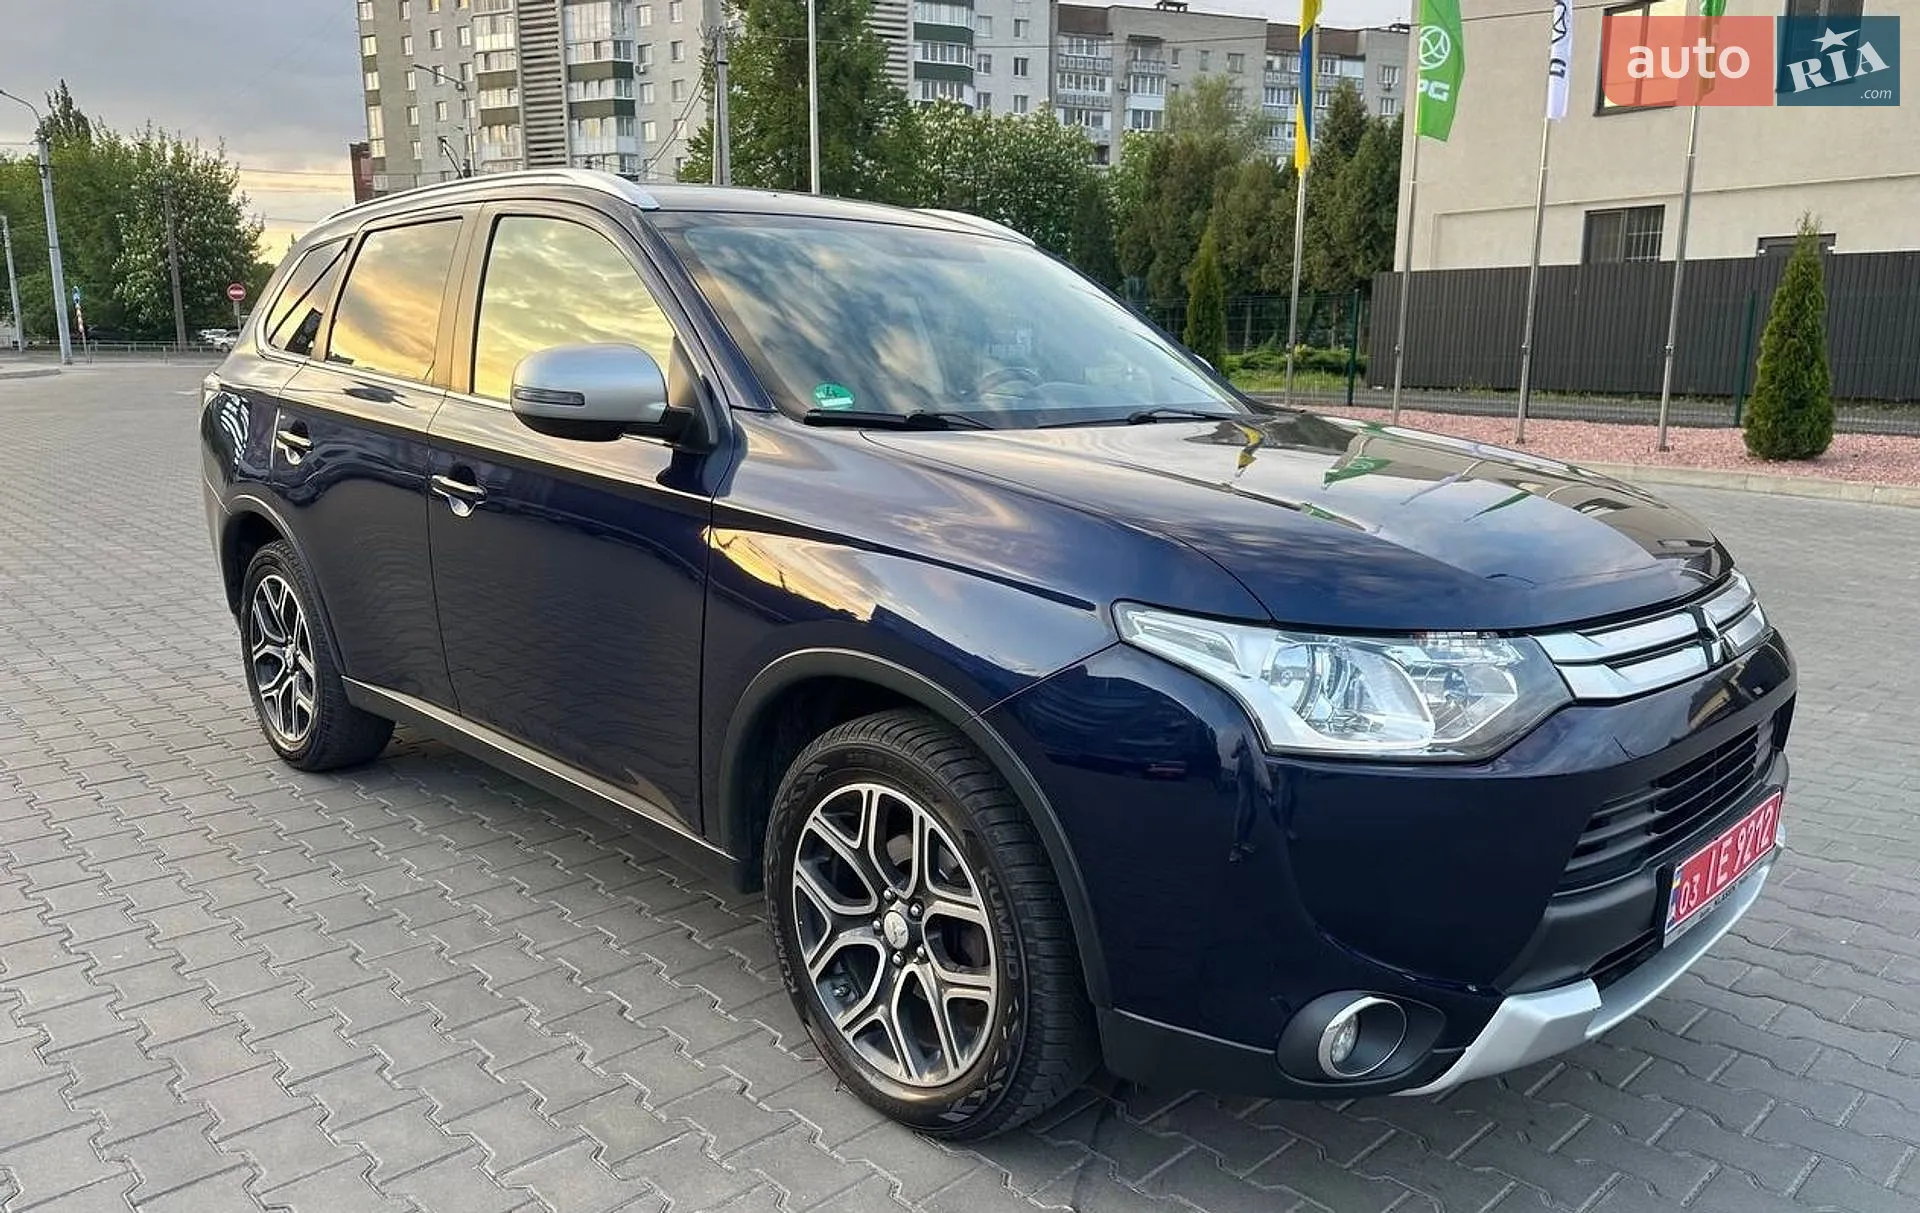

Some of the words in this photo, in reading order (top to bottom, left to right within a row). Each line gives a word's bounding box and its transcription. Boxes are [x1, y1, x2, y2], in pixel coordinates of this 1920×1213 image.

[1418, 79, 1450, 102] PG
[1680, 873, 1700, 916] 03
[1733, 805, 1774, 873] 9212
